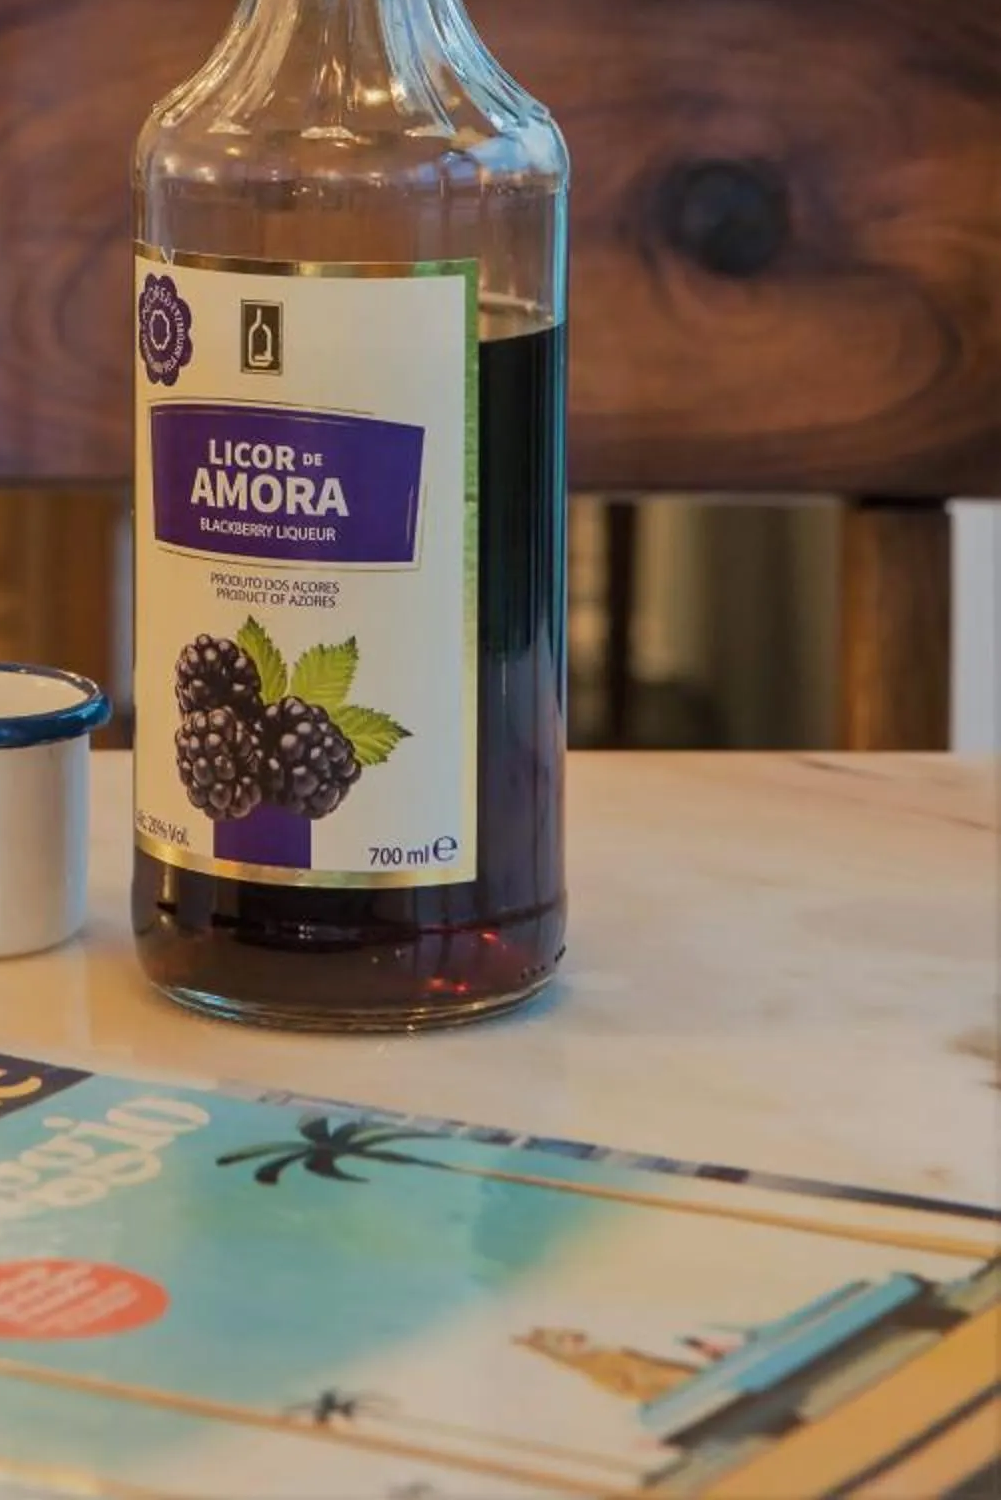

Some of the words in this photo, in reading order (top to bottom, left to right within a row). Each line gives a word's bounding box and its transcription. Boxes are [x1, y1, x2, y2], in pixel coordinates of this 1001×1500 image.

[208, 438, 296, 471] LICOR
[302, 452, 323, 467] DE
[189, 467, 349, 517] AMORA
[200, 517, 274, 538] BLACKBERRY
[276, 524, 336, 542] LIQUEUR
[209, 571, 263, 589] PRODUTO
[264, 579, 290, 592] DOS
[216, 587, 267, 604] PRODUCT
[270, 593, 286, 605] OF
[288, 595, 336, 608] AZORES
[367, 846, 403, 866] 700
[406, 844, 430, 864] ml
